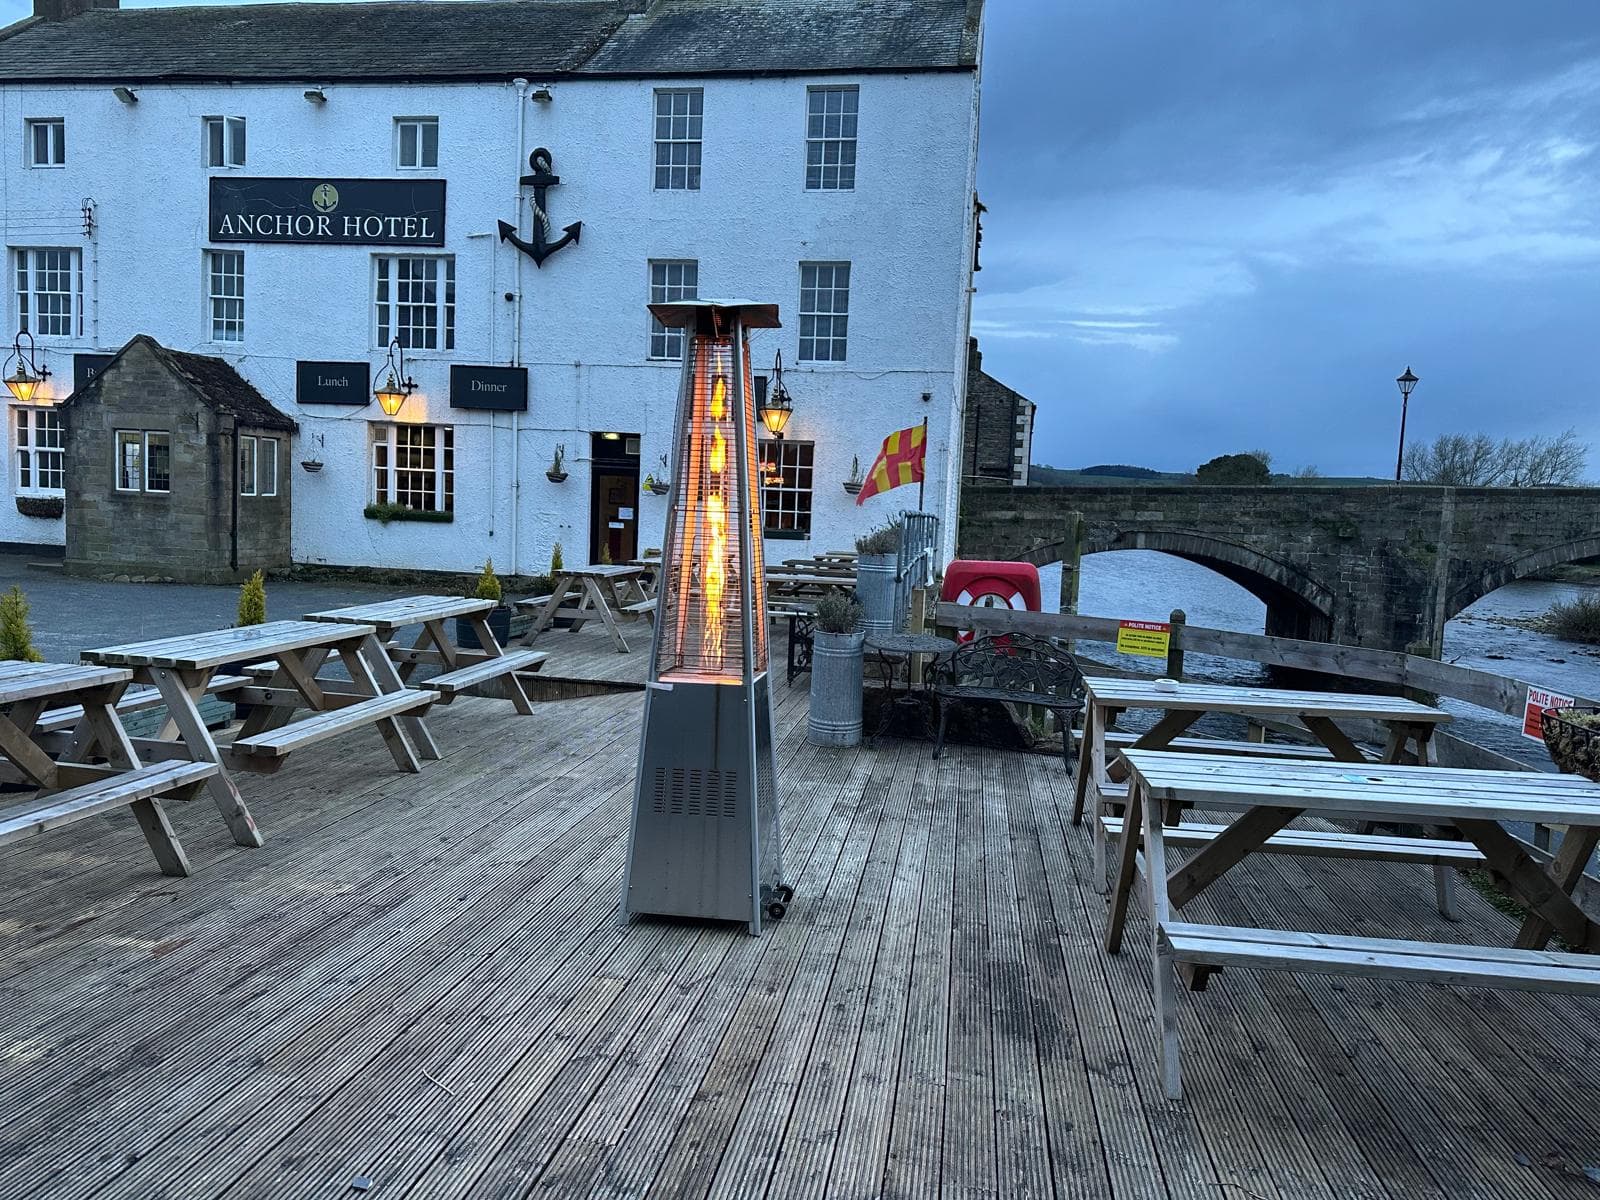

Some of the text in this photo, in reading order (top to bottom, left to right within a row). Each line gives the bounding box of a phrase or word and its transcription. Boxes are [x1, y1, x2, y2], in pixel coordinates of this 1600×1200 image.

[218, 214, 435, 238] ANCHOR HOTEL
[318, 375, 349, 387] Lunch
[471, 380, 508, 392] Dinner
[1528, 688, 1549, 705] POLITE
